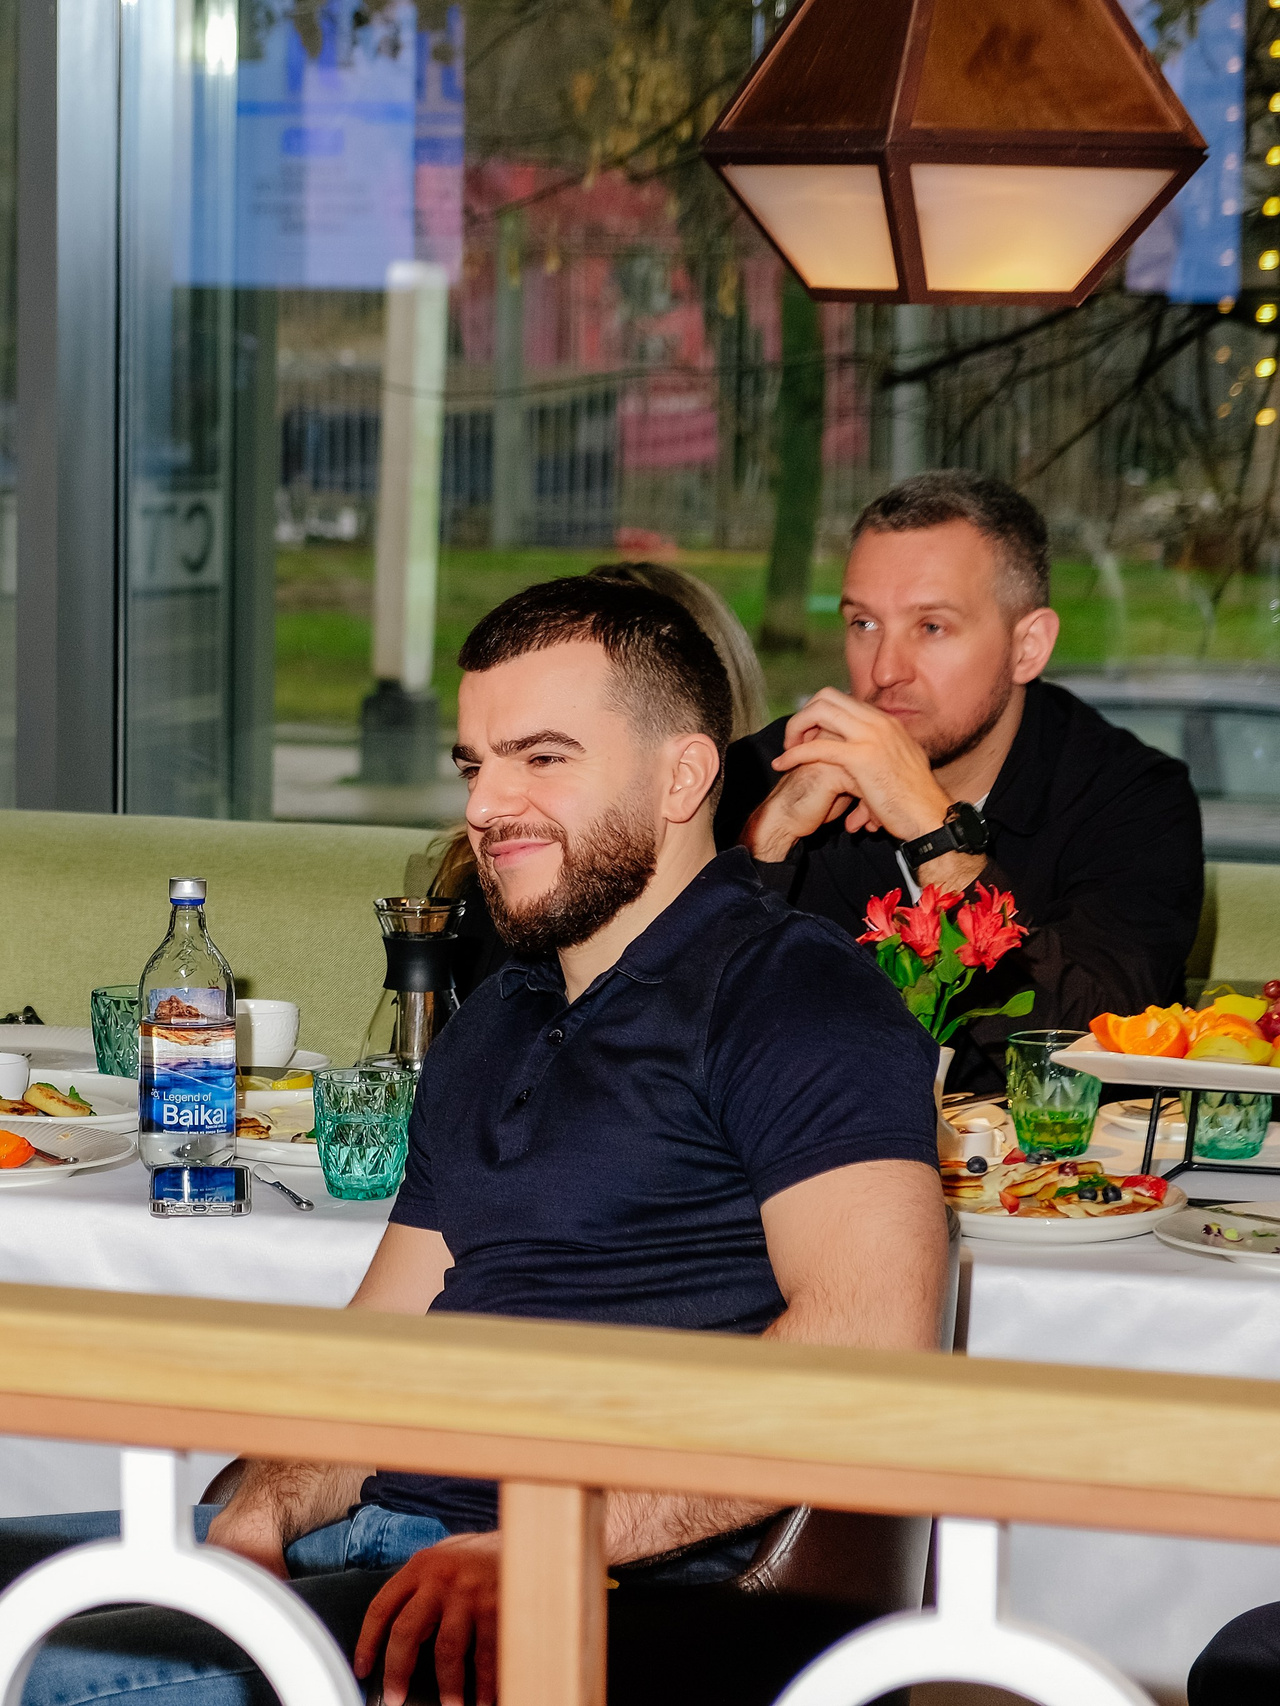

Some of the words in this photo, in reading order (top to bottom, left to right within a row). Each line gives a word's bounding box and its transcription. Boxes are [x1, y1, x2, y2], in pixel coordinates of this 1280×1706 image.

[163, 1091, 201, 1103] Legend
[202, 1092, 212, 1102] of
[163, 1103, 227, 1126] Baikal
